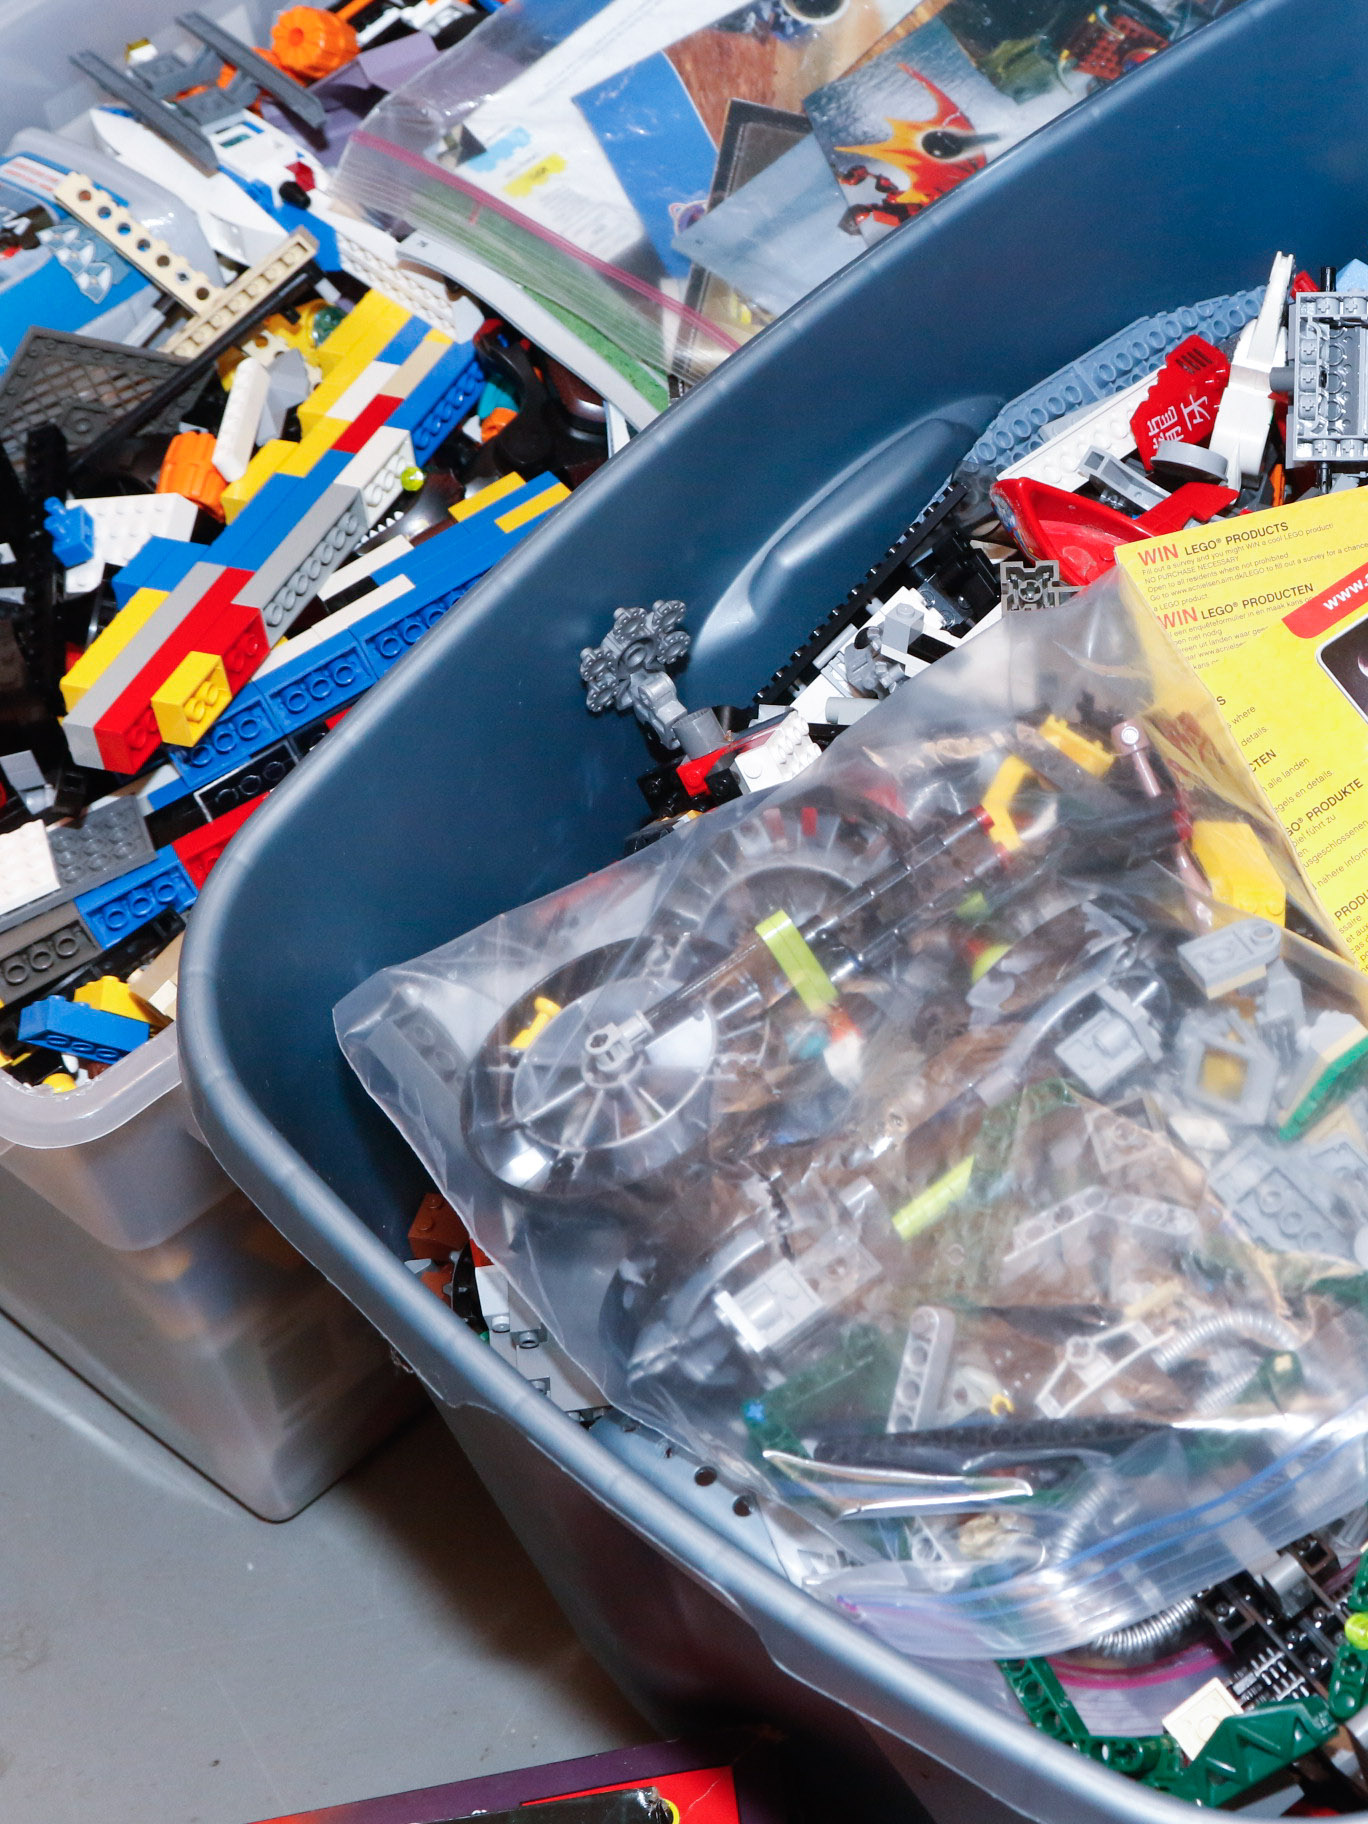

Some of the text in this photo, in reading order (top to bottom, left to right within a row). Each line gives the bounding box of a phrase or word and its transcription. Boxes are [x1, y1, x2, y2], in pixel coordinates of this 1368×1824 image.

[1138, 544, 1178, 566] WIN
[1225, 522, 1288, 545] PRODUCTS
[1153, 565, 1165, 573] out
[1172, 559, 1194, 568] survey
[1196, 554, 1210, 562] and
[1211, 552, 1224, 560] you
[1225, 546, 1244, 554] might
[1267, 535, 1282, 544] cool
[1283, 530, 1304, 540] LEGO
[1144, 556, 1238, 584] NO PURCHASE NECESSARY
[1147, 584, 1166, 593] Open
[1186, 571, 1217, 582] residents
[1219, 566, 1239, 574] where
[1254, 552, 1288, 567] prohibited
[1171, 568, 1264, 595] www.acnielsen.aim.dk/LEGO
[1303, 553, 1325, 562] survey
[1343, 543, 1368, 552] chance
[1158, 607, 1198, 629] WIN
[1242, 584, 1313, 608] PRODUCTEN
[1159, 600, 1180, 610] LEGO
[1181, 593, 1208, 606] product
[1266, 603, 1285, 612] maak
[1286, 599, 1303, 607] kans
[1202, 629, 1222, 638] nodig
[1208, 636, 1232, 645] landen
[1234, 631, 1250, 639] waar
[1232, 706, 1255, 724] where
[1267, 777, 1282, 789] alle
[1281, 758, 1309, 778] landen
[1295, 788, 1306, 798] en
[1306, 779, 1363, 821] PRODUKTE
[1325, 814, 1336, 824] zu
[1346, 934, 1355, 943] et
